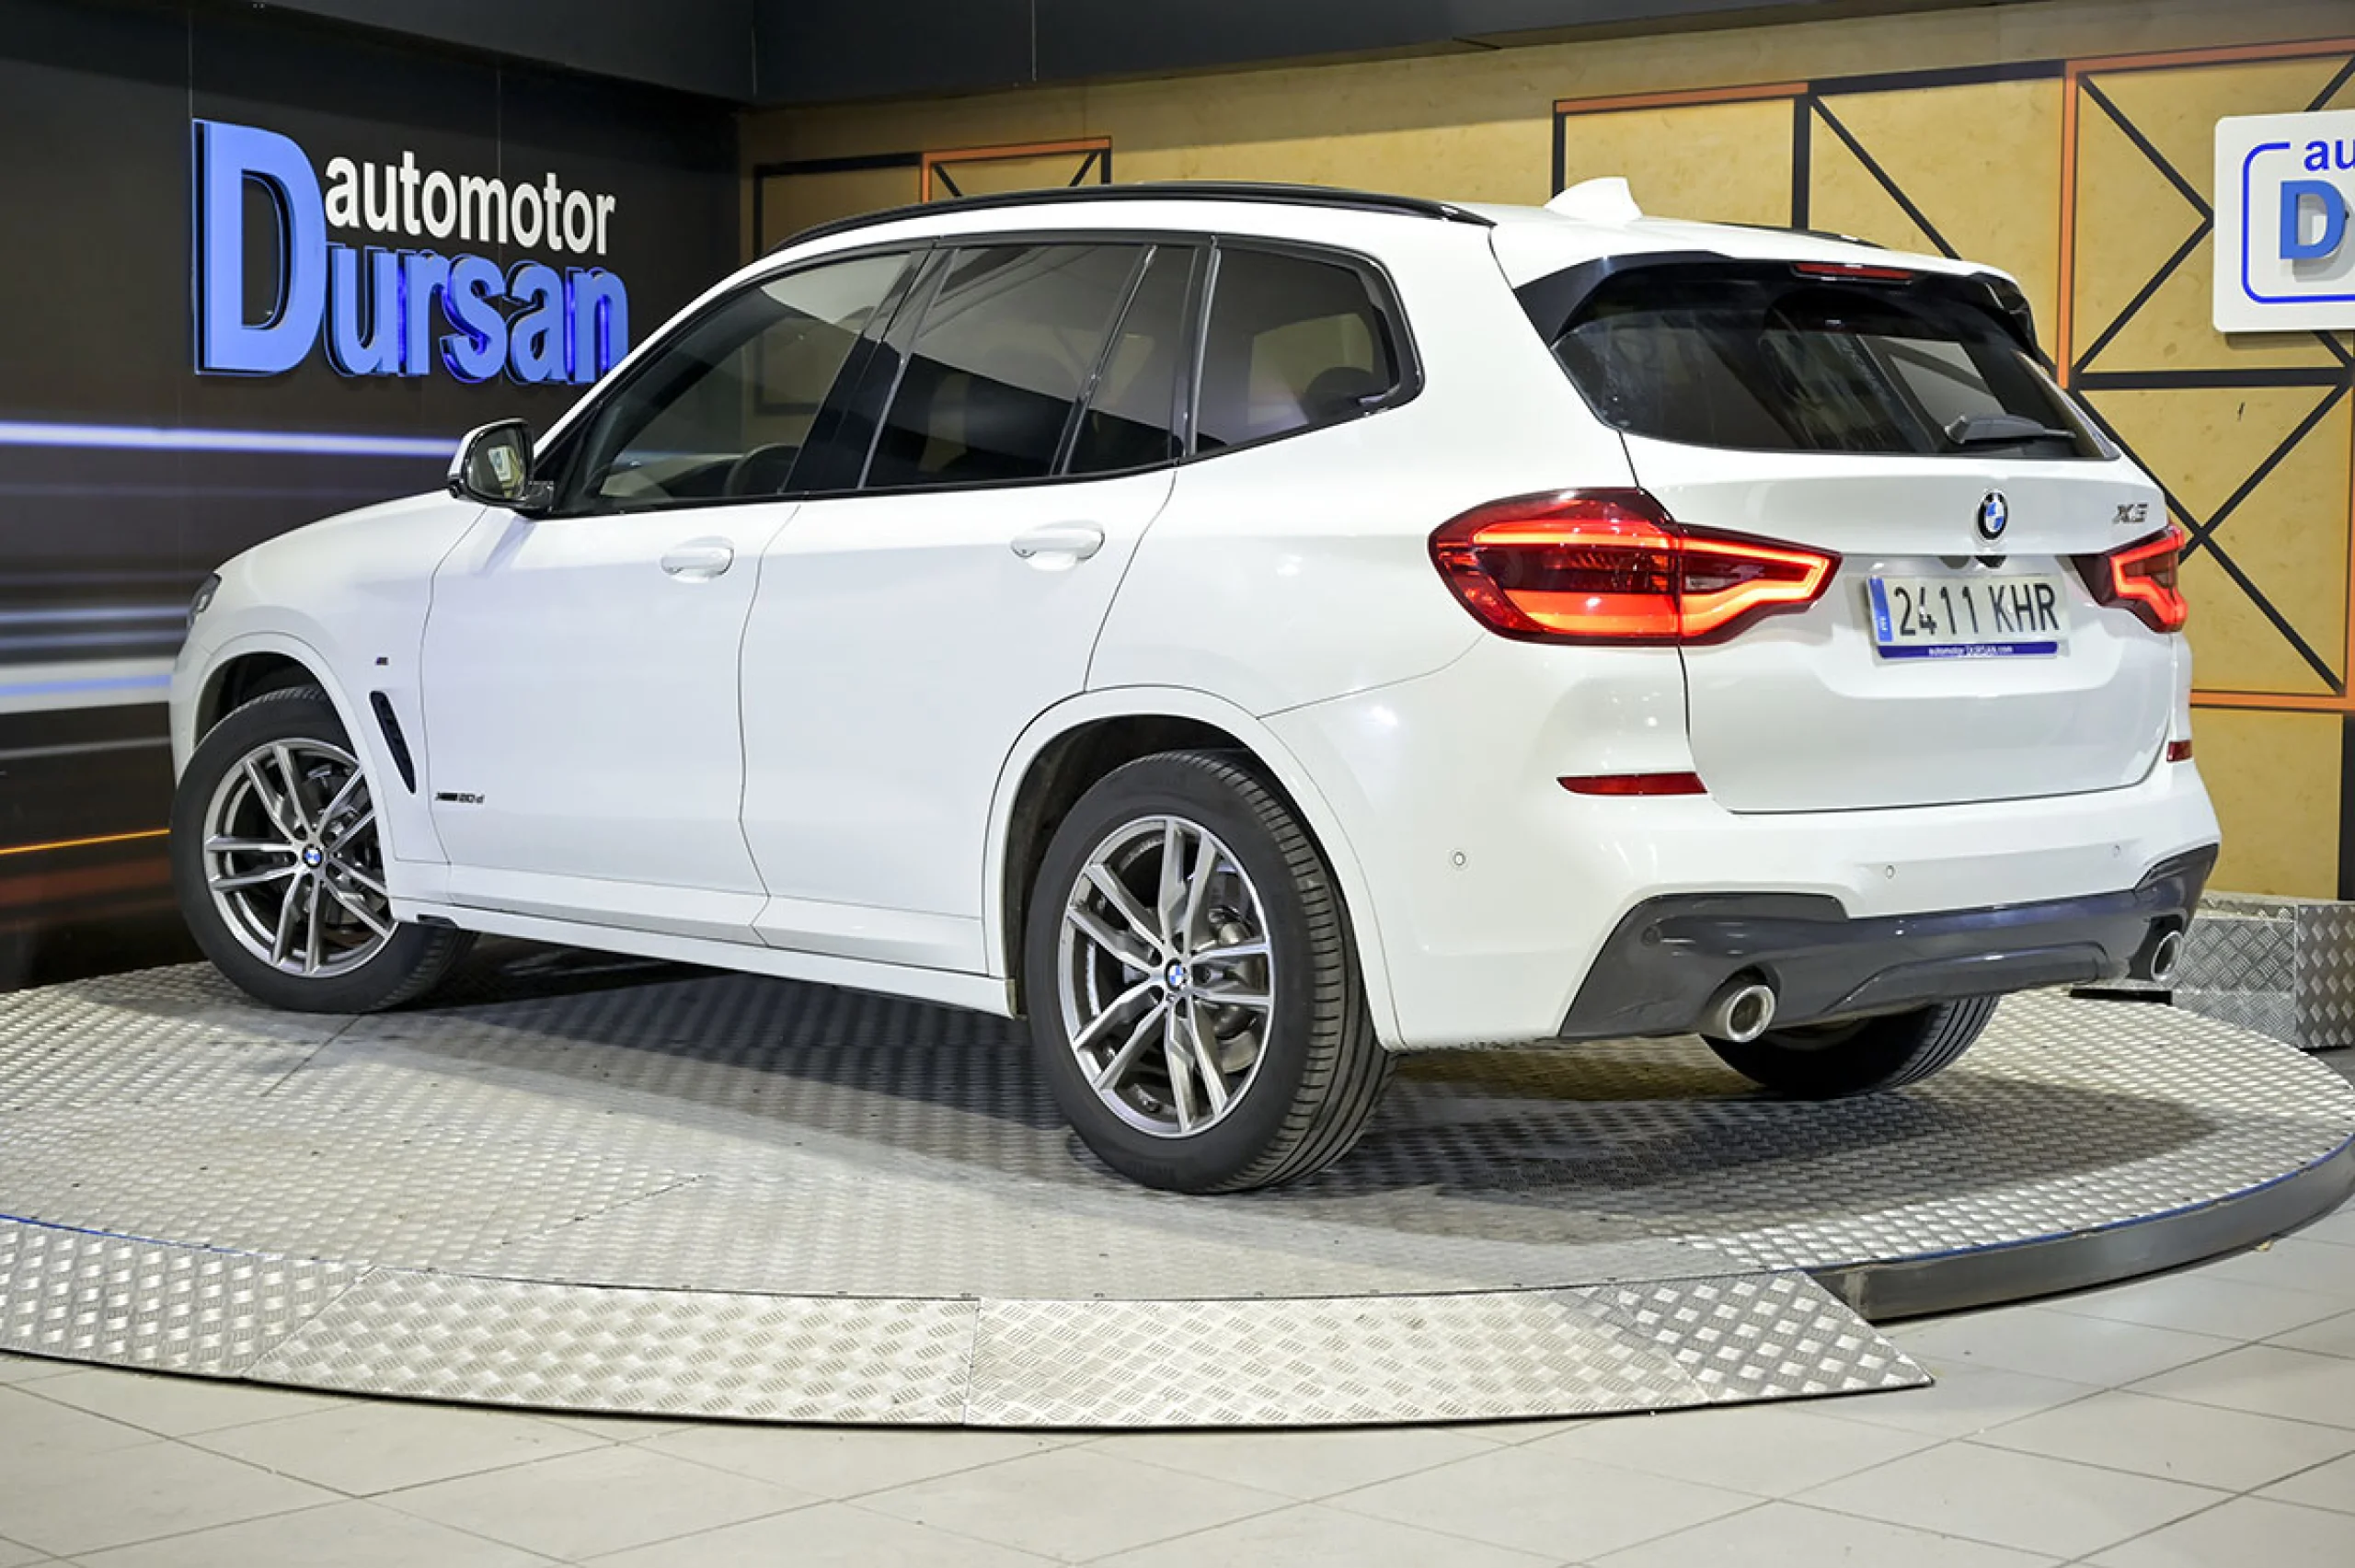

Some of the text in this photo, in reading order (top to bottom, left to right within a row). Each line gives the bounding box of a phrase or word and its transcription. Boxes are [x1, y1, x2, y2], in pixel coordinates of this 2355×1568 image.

[192, 118, 629, 383] Dursan
[325, 151, 615, 255] automotor
[1894, 582, 2060, 635] 2411 KHR
